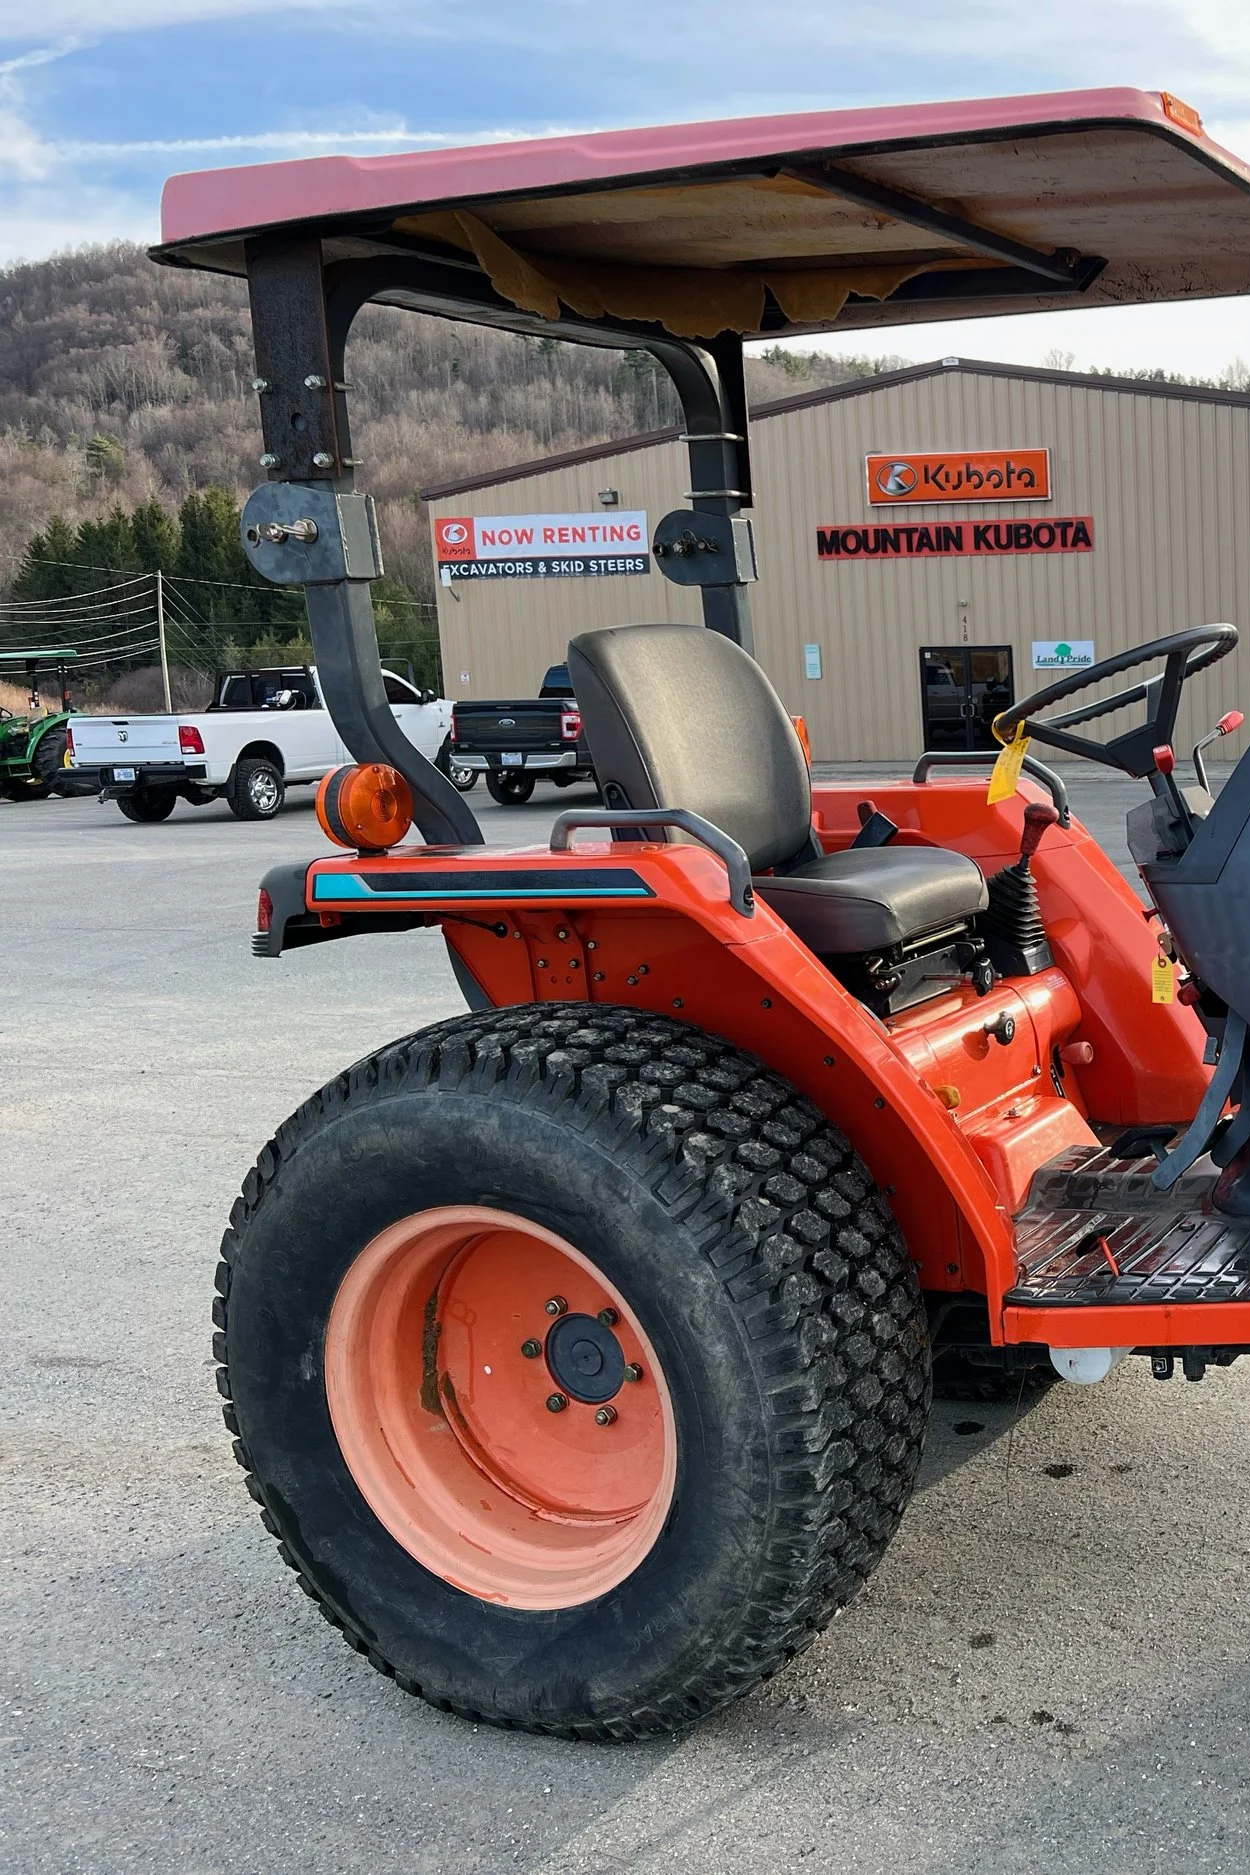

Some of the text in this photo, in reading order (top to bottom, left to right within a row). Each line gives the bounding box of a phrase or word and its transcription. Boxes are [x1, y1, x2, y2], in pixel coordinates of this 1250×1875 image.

[923, 461, 1036, 491] Kubota
[481, 524, 641, 546] NOW RENTING
[817, 521, 1092, 555] MOUNTAIN KUBOTA
[441, 546, 471, 555] Kubota
[538, 562, 547, 573] &
[552, 560, 584, 573] SKID
[589, 558, 644, 572] STEERS
[1036, 654, 1092, 664] Land Pride
